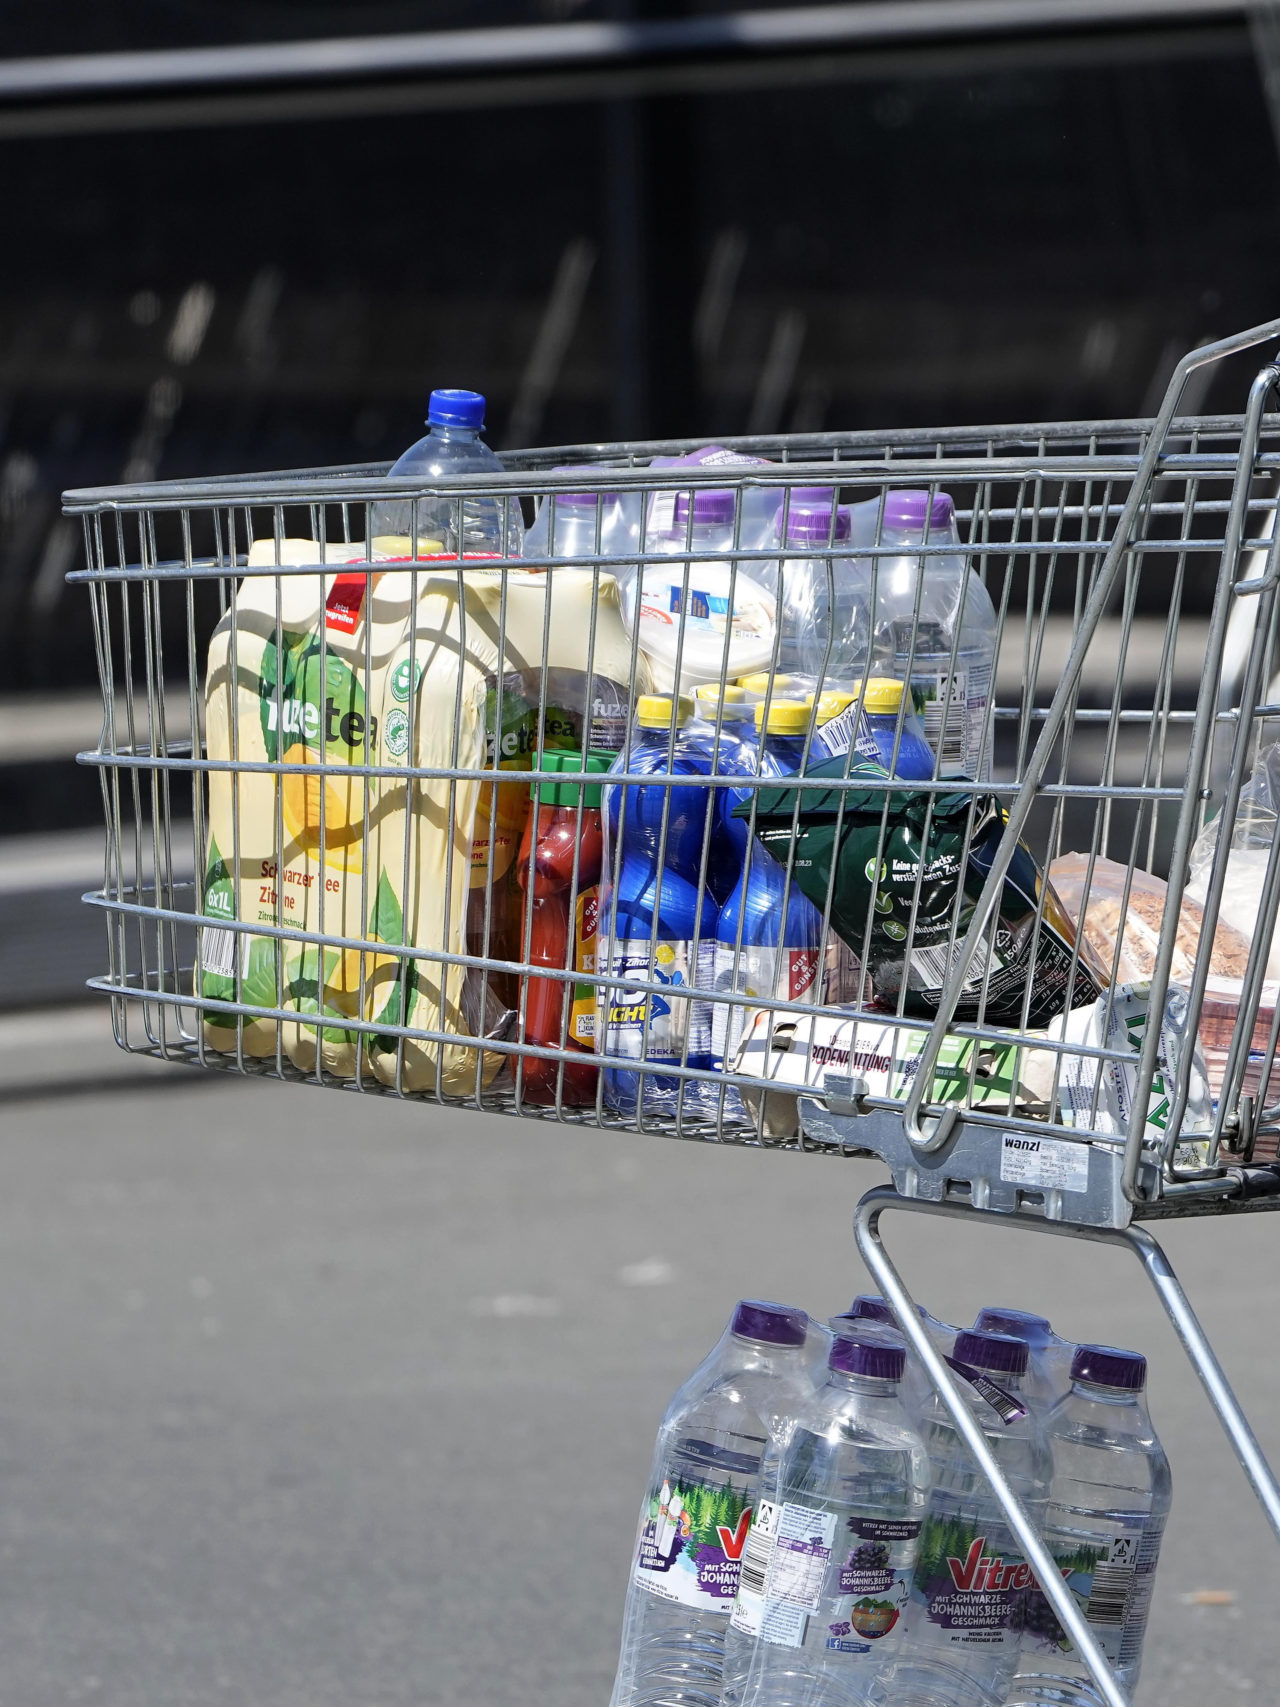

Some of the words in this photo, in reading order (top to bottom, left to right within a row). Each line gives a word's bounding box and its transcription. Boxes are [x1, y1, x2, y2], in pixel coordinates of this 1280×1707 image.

[592, 699, 629, 717] fuze
[266, 685, 320, 739] fuze
[320, 697, 378, 751] tea
[892, 858, 911, 871] Keine
[318, 872, 340, 893] ee
[208, 888, 231, 912] 6x1L
[259, 885, 295, 910] Zitrne
[792, 953, 808, 973] GUT
[801, 965, 808, 973] &
[1005, 1137, 1041, 1152] wanzl
[704, 1564, 720, 1572] MIT
[841, 1577, 894, 1586] JOHANNISBEERE-
[852, 1585, 886, 1593] GESCHMACK
[934, 1595, 950, 1603] MIT
[950, 1594, 1006, 1604] SCHWARZE-
[931, 1603, 1016, 1617] JOHANNISBEERE-
[951, 1616, 1000, 1626] GESCHMACK
